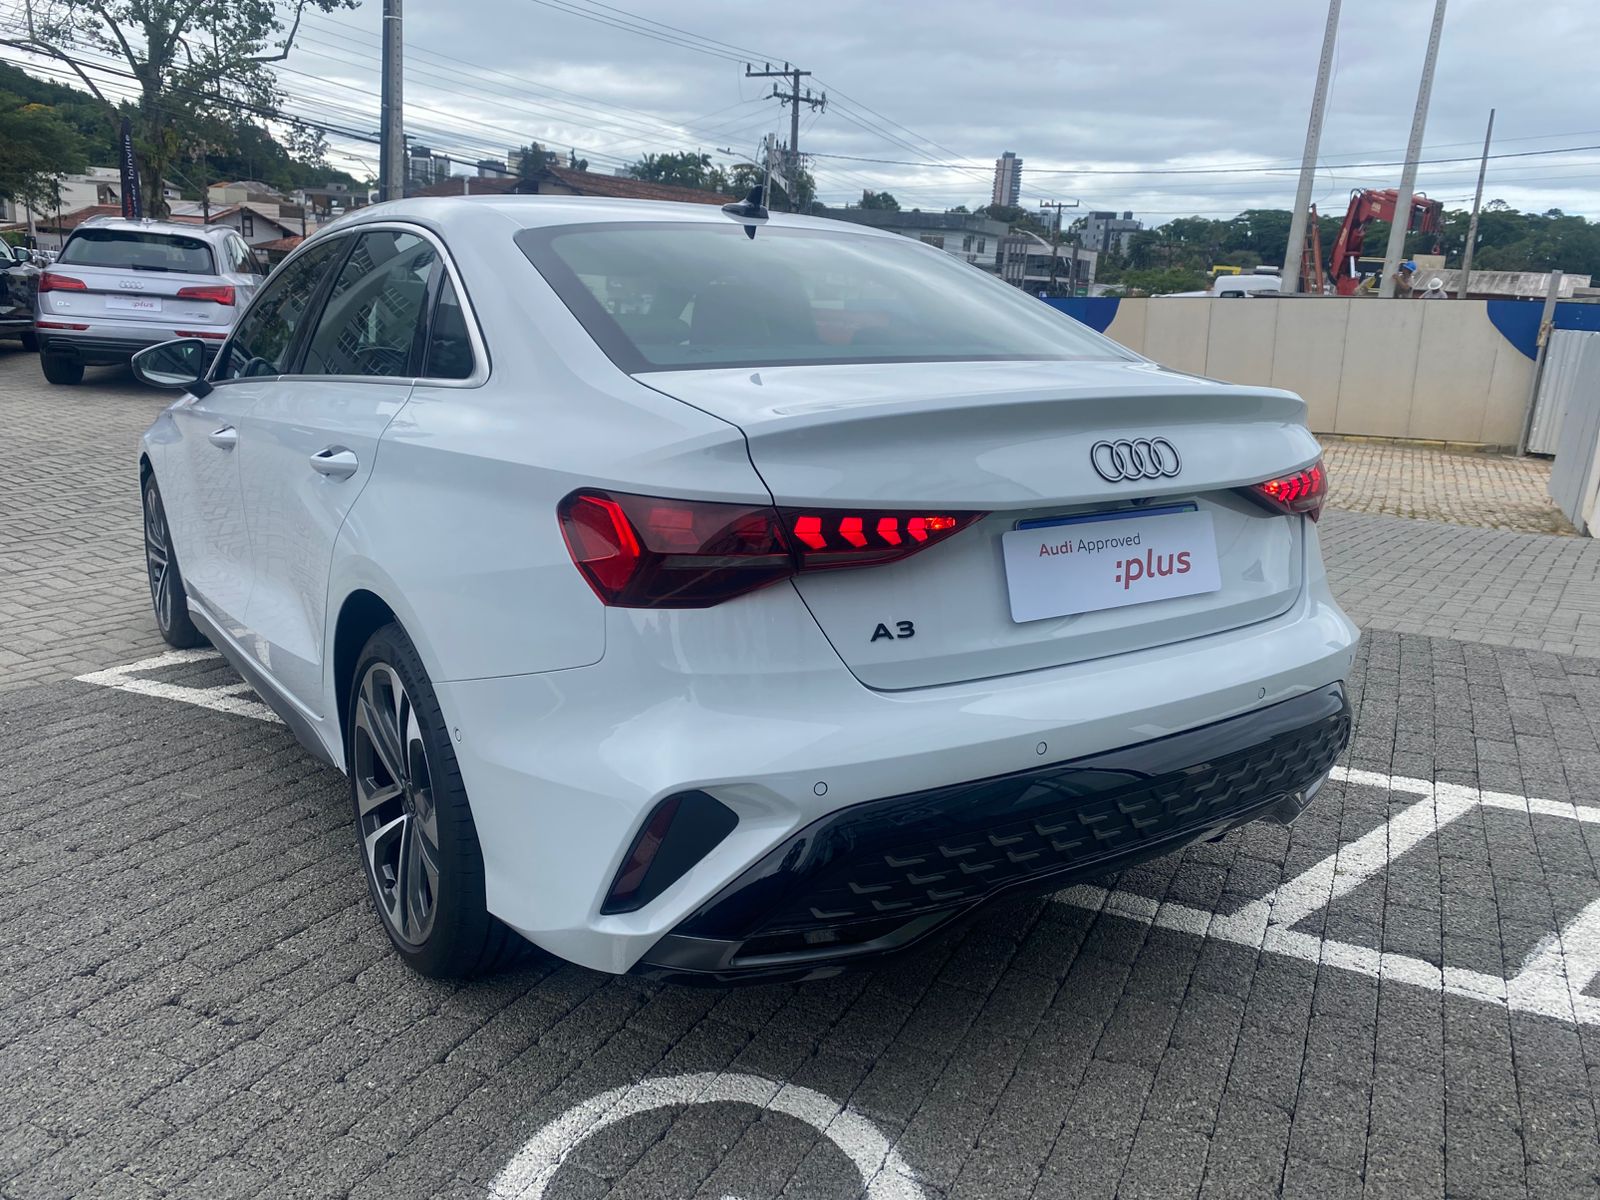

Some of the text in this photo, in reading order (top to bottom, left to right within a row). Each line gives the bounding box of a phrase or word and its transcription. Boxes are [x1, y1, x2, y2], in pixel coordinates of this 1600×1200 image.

[1039, 532, 1141, 557] Audi Approved
[870, 620, 915, 643] A3
